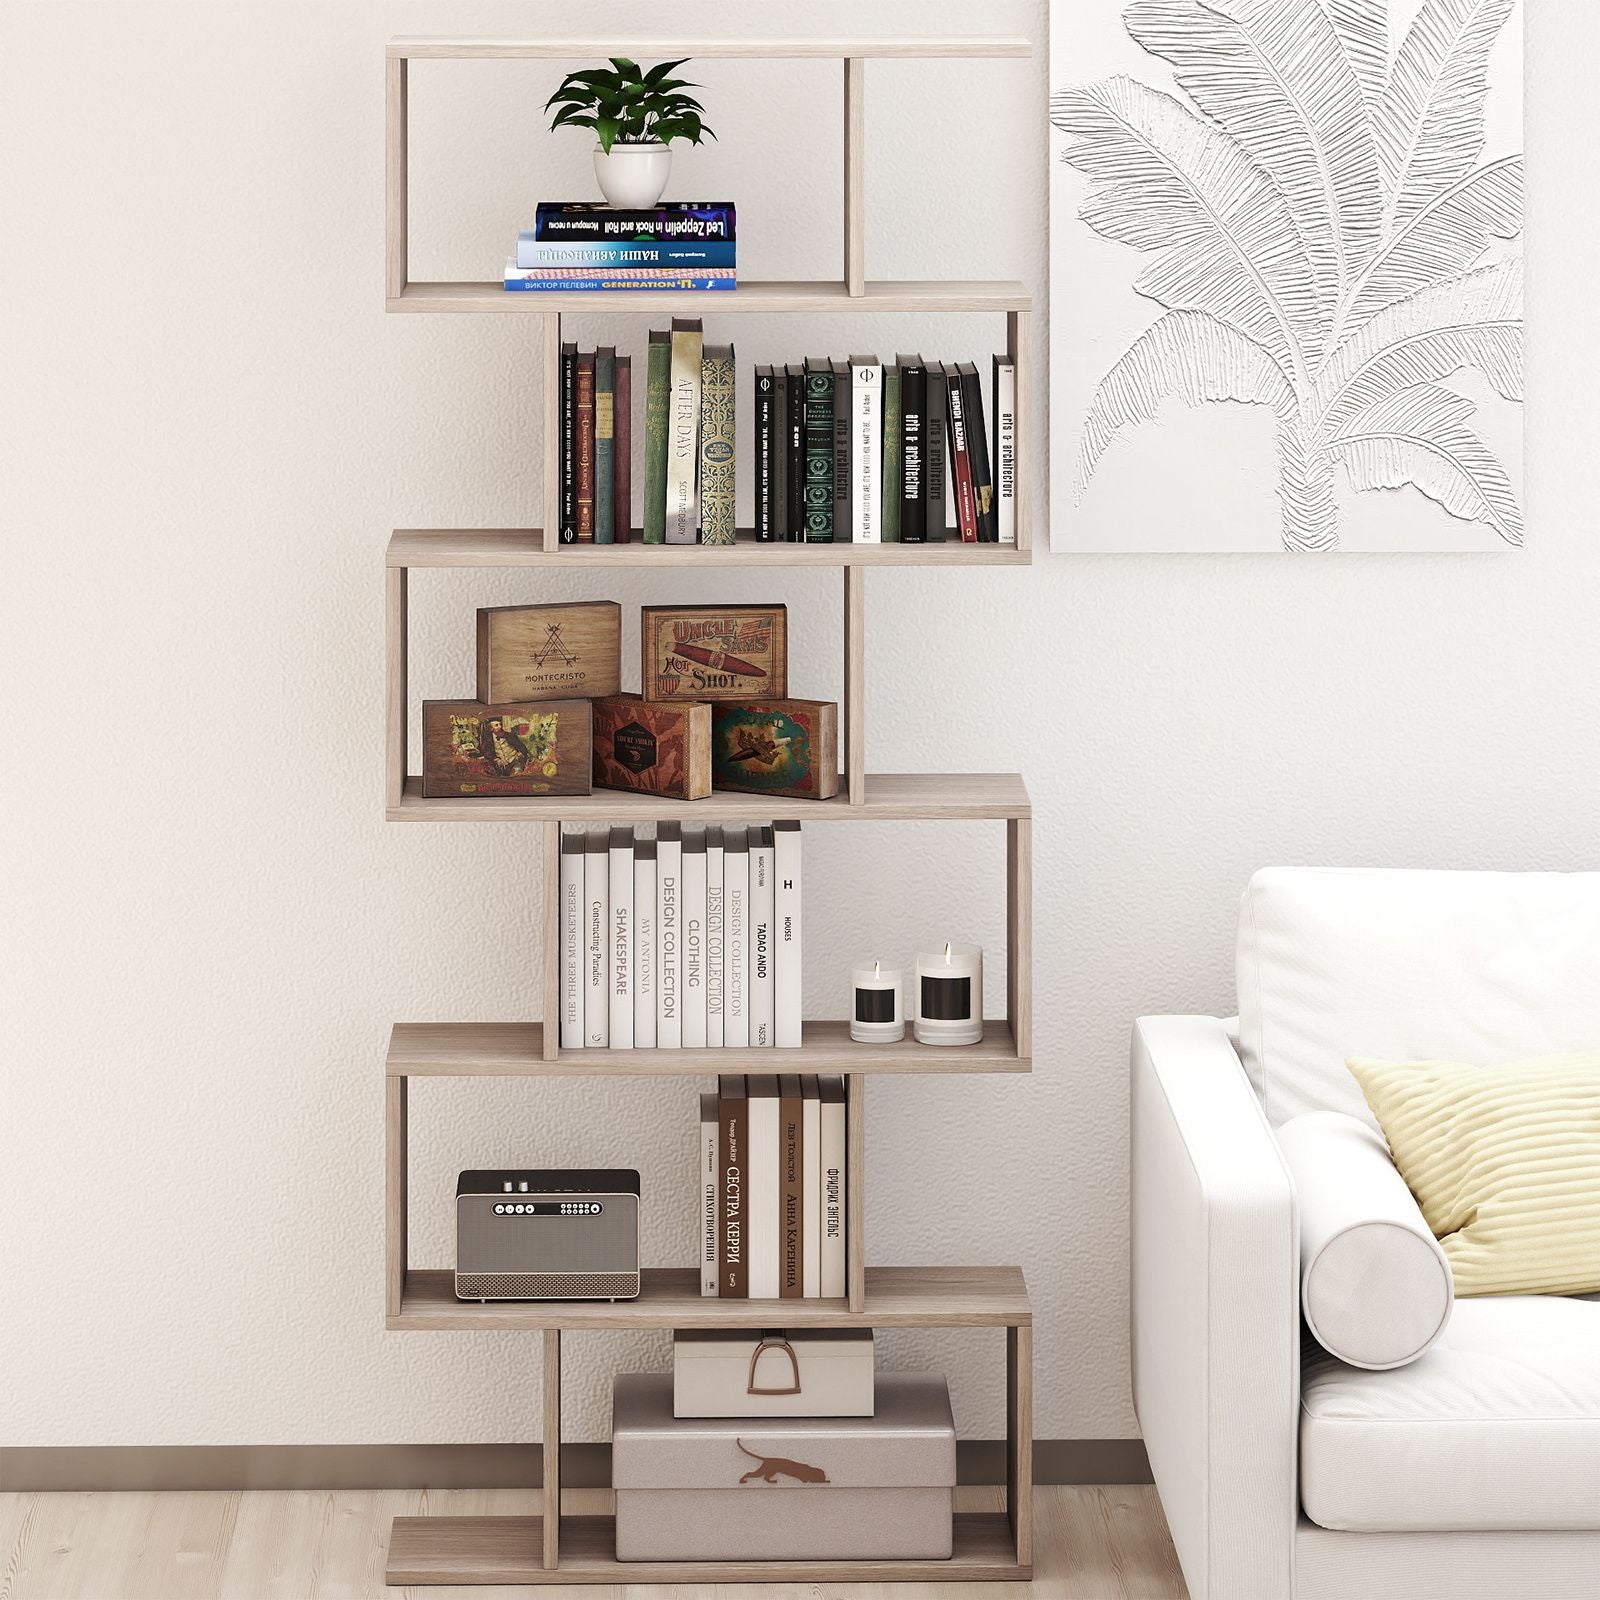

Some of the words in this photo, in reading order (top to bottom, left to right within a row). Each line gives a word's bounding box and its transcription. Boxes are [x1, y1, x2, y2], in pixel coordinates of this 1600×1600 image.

[604, 222, 620, 234] Roll
[621, 221, 635, 234] and
[636, 221, 654, 234] Rock
[655, 222, 663, 233] in
[665, 218, 704, 236] Zeppelin
[706, 220, 724, 236] Led
[620, 250, 660, 260] НАШИ
[678, 378, 694, 421] AFTER
[951, 390, 962, 419] BHENDI
[836, 419, 848, 436] arts
[905, 414, 920, 432] arts
[930, 418, 942, 434] arts
[1002, 413, 1013, 430] arts
[676, 425, 692, 458] DAYS
[954, 422, 965, 452] BAZAAR
[580, 462, 589, 490] JOURNEY
[836, 450, 848, 500] architecture
[905, 446, 922, 499] architecture
[930, 449, 942, 500] architecture
[1002, 445, 1014, 498] architecture
[679, 480, 688, 502] SCOTT
[673, 620, 738, 644] UNCLE
[526, 672, 586, 682] MONTECRISTO
[662, 656, 688, 674] HOT
[688, 668, 742, 690] SHOT.
[784, 880, 792, 889] H
[664, 877, 675, 928] DESIGN
[709, 887, 722, 933] DESIGN
[732, 890, 741, 936] DESIGN
[568, 883, 576, 958] MUSKETEERS
[590, 901, 602, 952] Constructing
[642, 918, 650, 936] MY
[784, 916, 792, 942] HOUSES
[616, 908, 627, 995] SHAKESPEARE
[758, 923, 766, 952] TADAO
[642, 940, 650, 994] ANTONIA
[688, 920, 700, 987] CLOTHING
[758, 954, 766, 978] ANDO
[568, 962, 576, 999] THREE
[664, 932, 675, 1018] COLLECTION
[709, 937, 722, 1015] COLLECTION
[732, 940, 741, 1016] COLLECTION
[568, 1002, 576, 1024] THE
[727, 1166, 740, 1218] СЕСТРА
[826, 1168, 840, 1203] ФРИДРИХ
[706, 1184, 714, 1262] СТИХОТВОРЕНИЯ
[827, 1206, 839, 1238] ЭНГЕЛЬС
[727, 1221, 740, 1263] КЕРРИ
